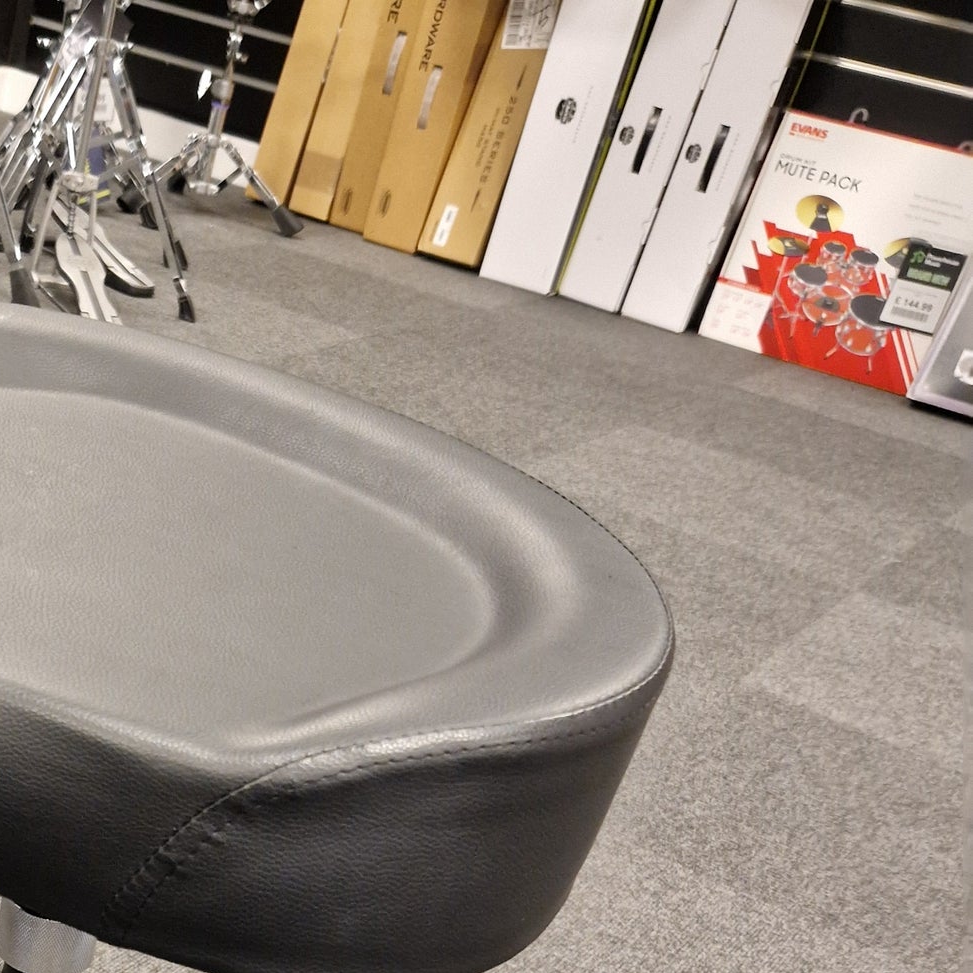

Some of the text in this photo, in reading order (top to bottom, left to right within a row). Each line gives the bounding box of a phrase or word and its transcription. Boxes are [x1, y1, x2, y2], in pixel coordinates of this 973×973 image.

[790, 122, 829, 139] EVANS
[774, 159, 863, 193] MUTE PACK
